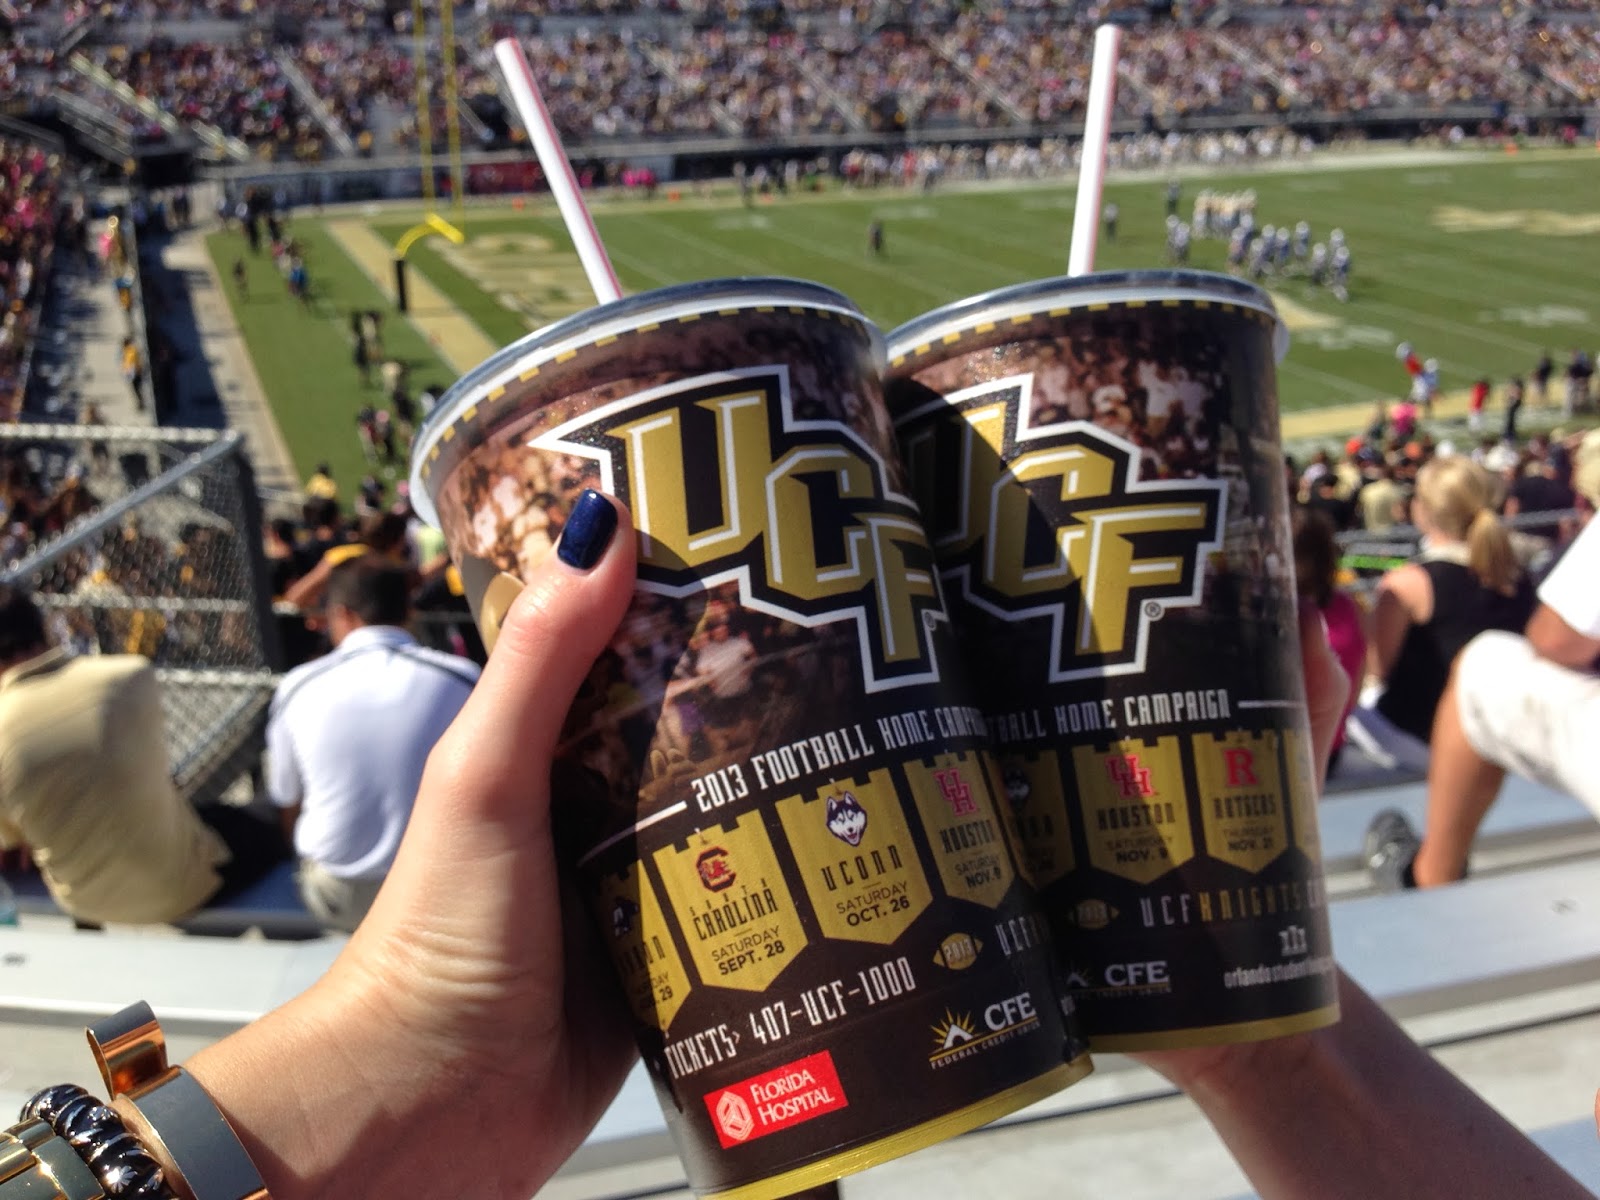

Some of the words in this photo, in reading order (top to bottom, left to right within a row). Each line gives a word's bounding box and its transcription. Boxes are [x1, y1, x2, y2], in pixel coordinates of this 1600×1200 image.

[598, 383, 940, 668] UCF
[903, 397, 1212, 660] UCF
[1053, 698, 1117, 735] HOME
[1123, 688, 1232, 728] CAMPAIGN
[691, 763, 749, 813] 2013
[751, 723, 875, 790] FOOTBALL
[876, 709, 935, 750] HOME
[821, 844, 903, 892] UCONN
[692, 888, 780, 941] CAROLINA
[836, 881, 908, 914] SATURDAY
[846, 904, 888, 927] OCT.
[889, 895, 911, 913] 26
[711, 925, 781, 962] SATURDAY
[718, 950, 763, 976] SEPT.
[764, 939, 786, 958] 28
[943, 937, 975, 962] 2013
[1104, 959, 1170, 987] CFE
[664, 1023, 737, 1080] TICKETS
[749, 956, 917, 1045] 407-UCF-1000
[984, 991, 1038, 1032] CFE
[930, 1045, 980, 1071] FEDERAL
[751, 1068, 817, 1106] FLORIDA
[757, 1086, 836, 1126] HOSPITAL
